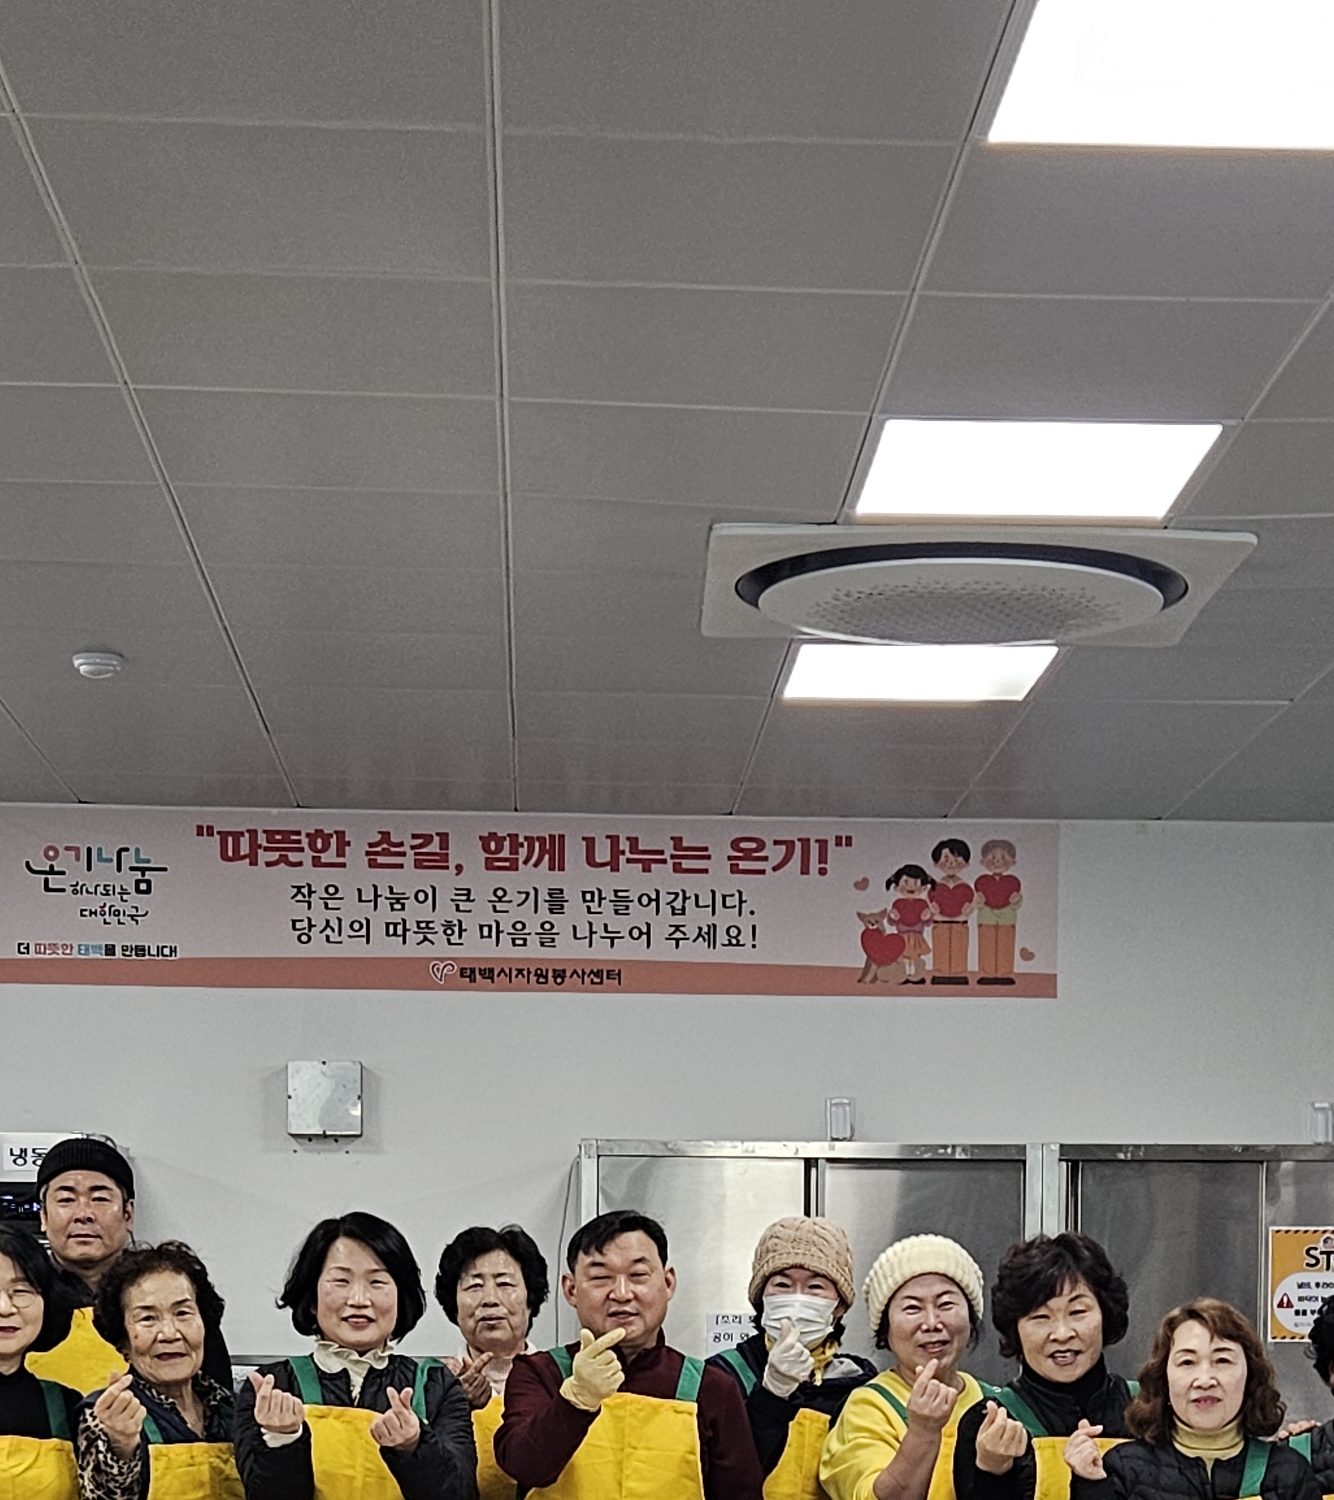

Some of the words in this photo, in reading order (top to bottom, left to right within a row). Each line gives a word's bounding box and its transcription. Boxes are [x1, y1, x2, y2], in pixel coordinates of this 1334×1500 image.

[196, 824, 352, 869] "따뜻한
[364, 829, 464, 877] 손길,
[478, 831, 566, 873] 함께
[581, 833, 712, 875] 나누는
[726, 834, 853, 877] 온기!"
[24, 844, 169, 896] 온기나눔
[79, 902, 149, 926] 대한민국
[290, 882, 345, 912] 작은
[356, 884, 438, 914] 나눔이
[449, 886, 476, 914] 큰
[487, 886, 569, 915] 온기를
[580, 887, 756, 918] 만들어갑니다.
[17, 942, 30, 956] 더
[290, 916, 371, 946] 당신의
[384, 917, 468, 947] 따뜻한
[478, 919, 561, 949] 마음을
[571, 920, 653, 950] 나누어
[664, 921, 758, 951] 주세요!
[458, 965, 623, 987] 태백시자원봉사센터
